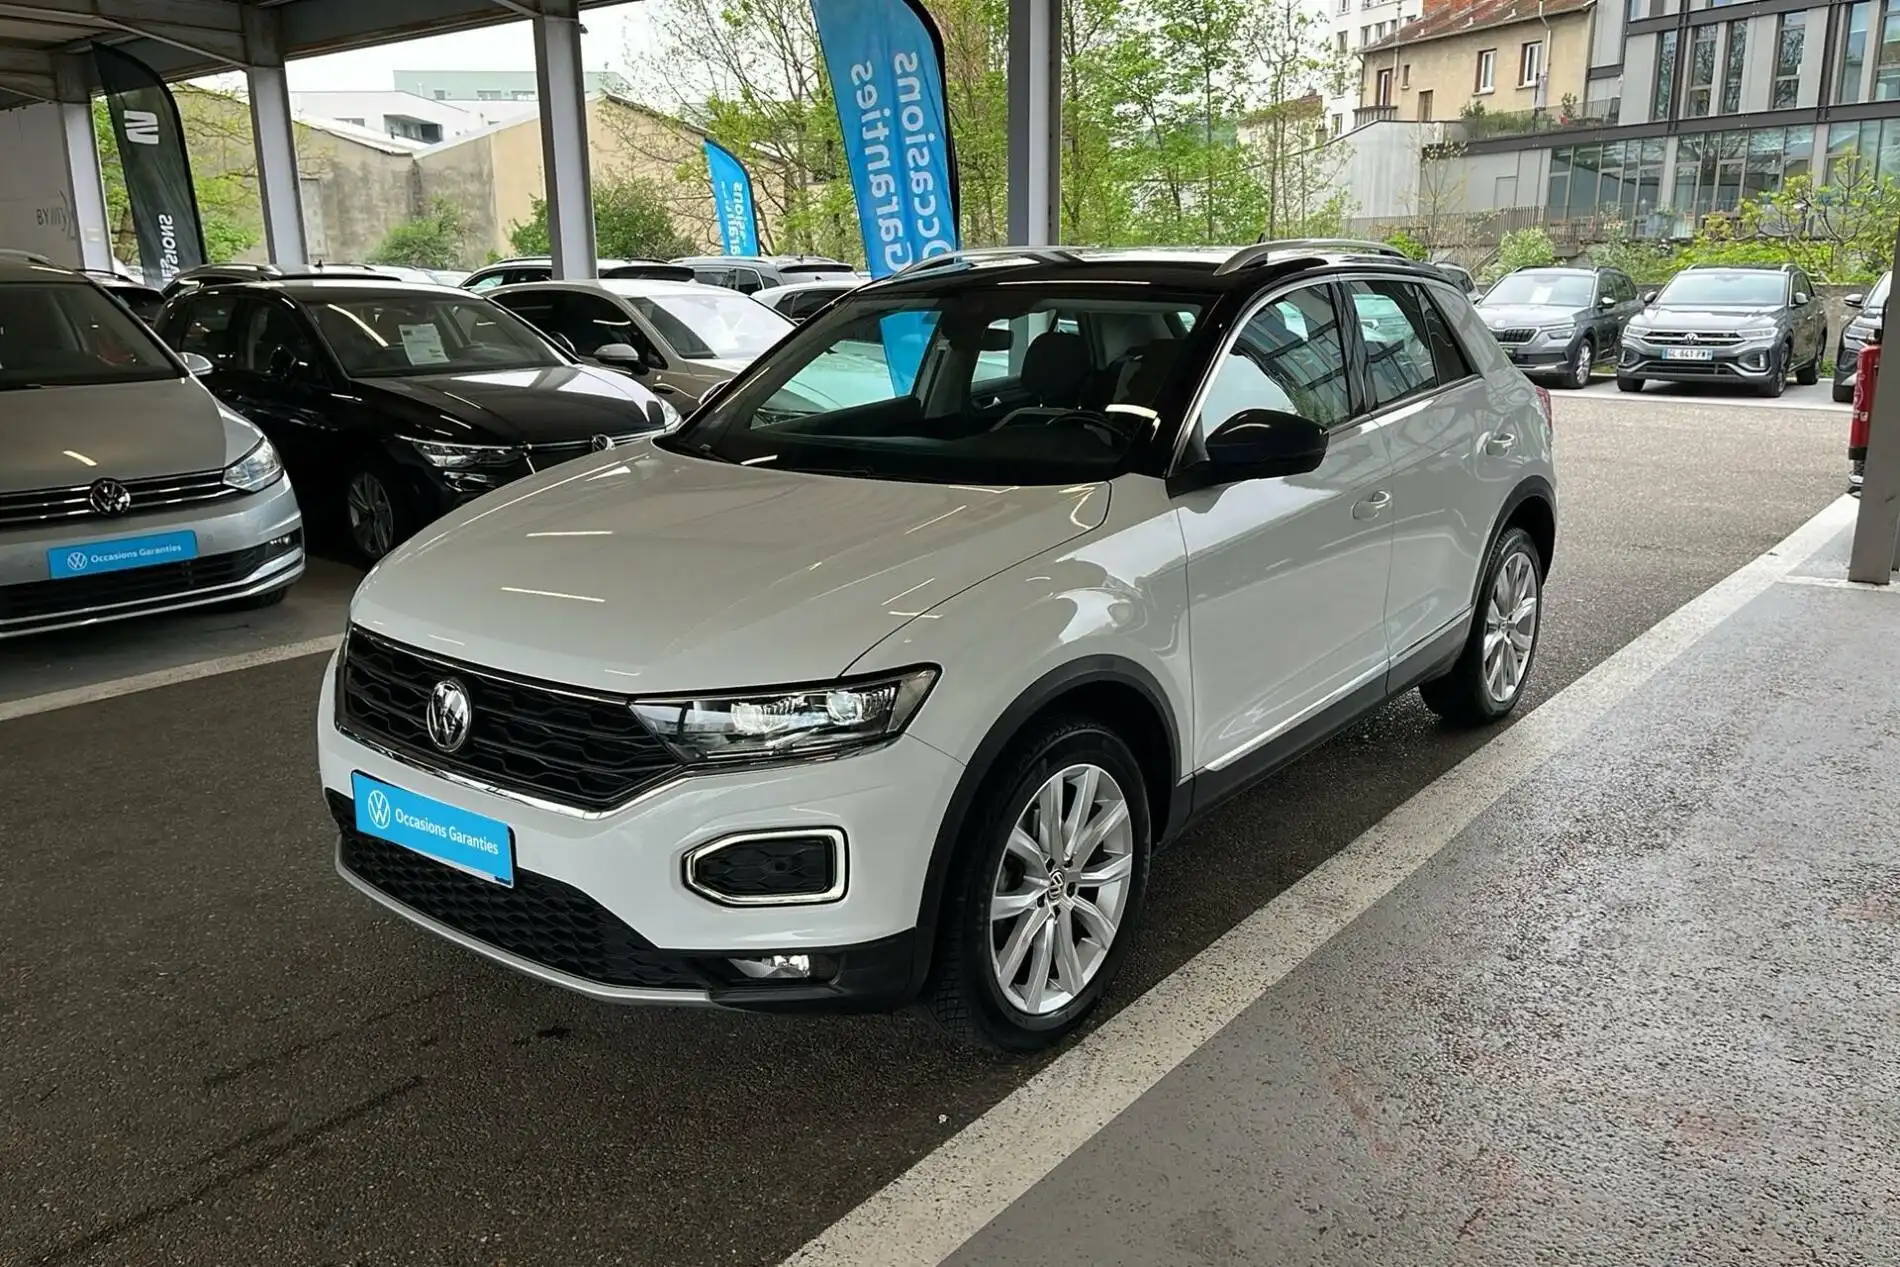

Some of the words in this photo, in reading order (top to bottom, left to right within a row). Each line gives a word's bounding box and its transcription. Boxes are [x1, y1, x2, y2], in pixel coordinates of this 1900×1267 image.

[90, 549, 138, 563] Occasions
[139, 544, 182, 557] Garanties
[395, 808, 448, 839] Occasions
[448, 826, 500, 856] Garanties
